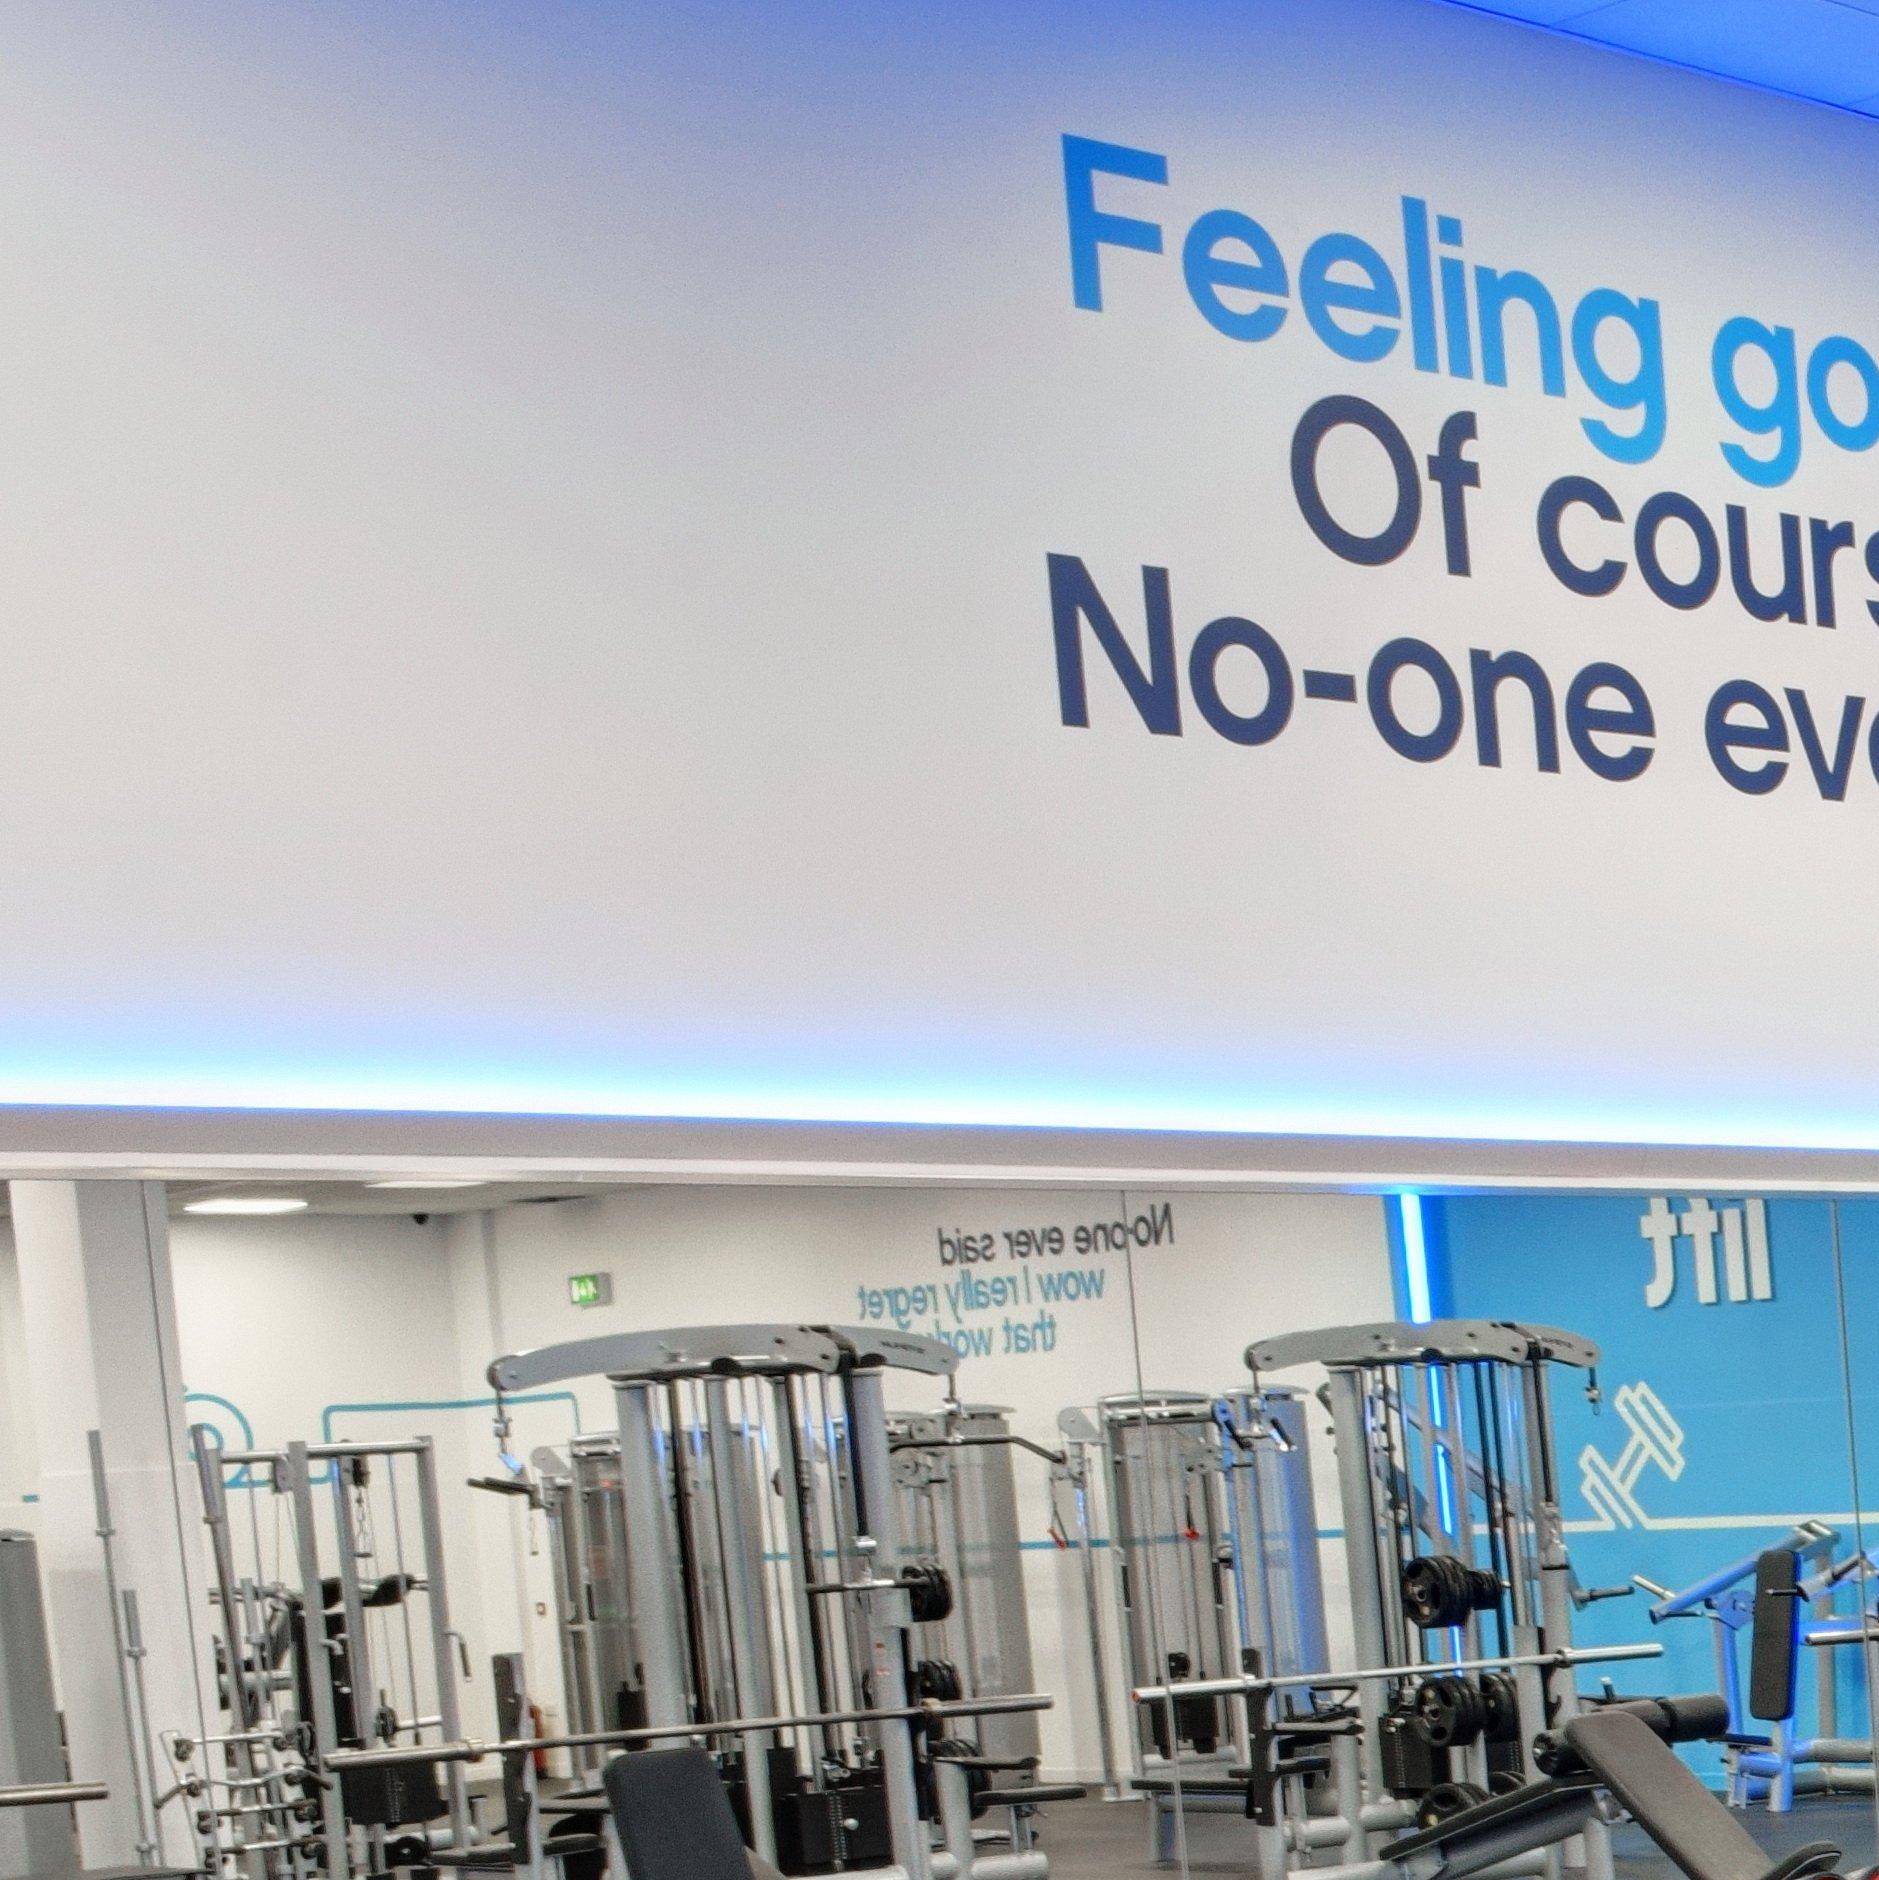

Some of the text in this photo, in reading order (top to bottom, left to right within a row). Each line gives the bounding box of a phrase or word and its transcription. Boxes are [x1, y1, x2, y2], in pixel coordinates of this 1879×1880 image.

[1061, 132, 1669, 464] Feeling
[1289, 394, 1481, 577] Of
[1047, 551, 1656, 781] No-one
